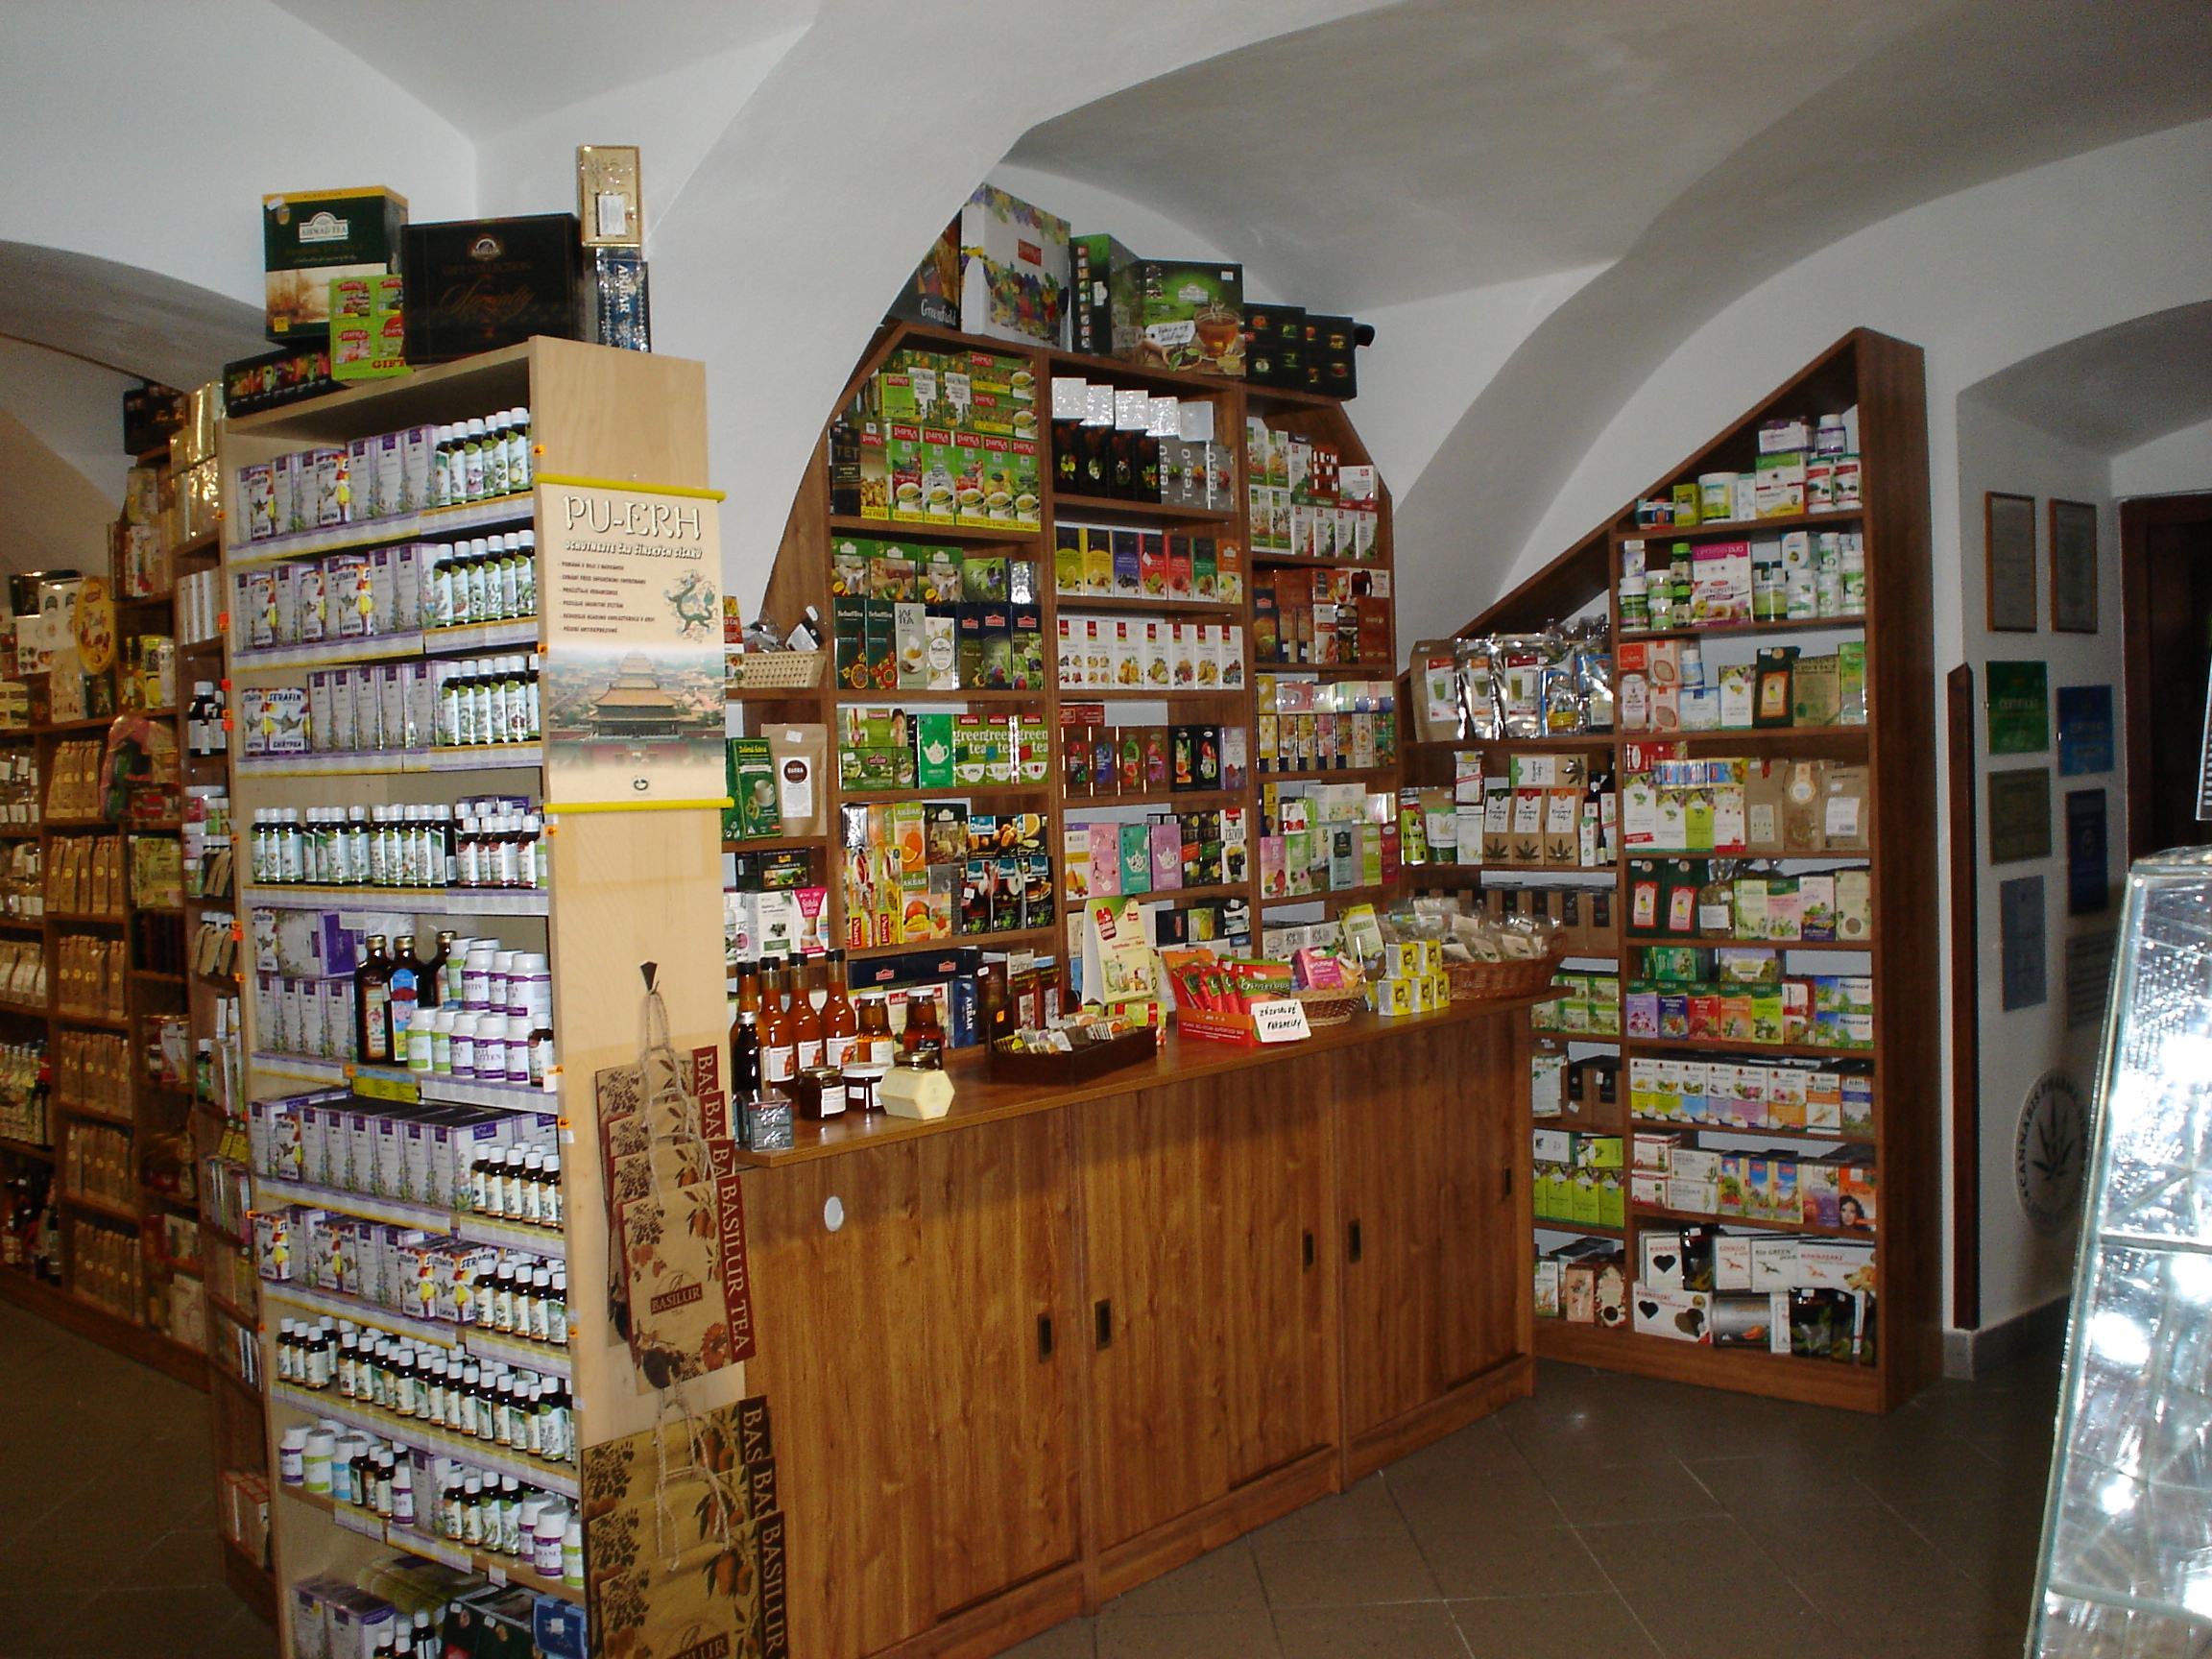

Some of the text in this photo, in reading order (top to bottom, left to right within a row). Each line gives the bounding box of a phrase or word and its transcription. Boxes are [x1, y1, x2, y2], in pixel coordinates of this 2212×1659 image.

[331, 226, 347, 234] TEA
[920, 299, 957, 326] Greenfield
[372, 359, 405, 369] GIFT
[563, 494, 702, 540] PU-ERH
[618, 542, 633, 556] ČAJ
[269, 693, 301, 702] SERAFIN
[984, 729, 1011, 744] gree
[1018, 729, 1048, 744] green
[969, 740, 987, 755] tea
[998, 739, 1011, 754] te
[1032, 739, 1048, 753] tea
[903, 878, 926, 887] AKBAR
[965, 997, 974, 1030] AKBAR
[704, 1098, 723, 1140] BA
[721, 1184, 750, 1353] BASILUR TEA
[652, 1286, 704, 1312] BASILUR
[762, 1522, 786, 1656] BASILUR
